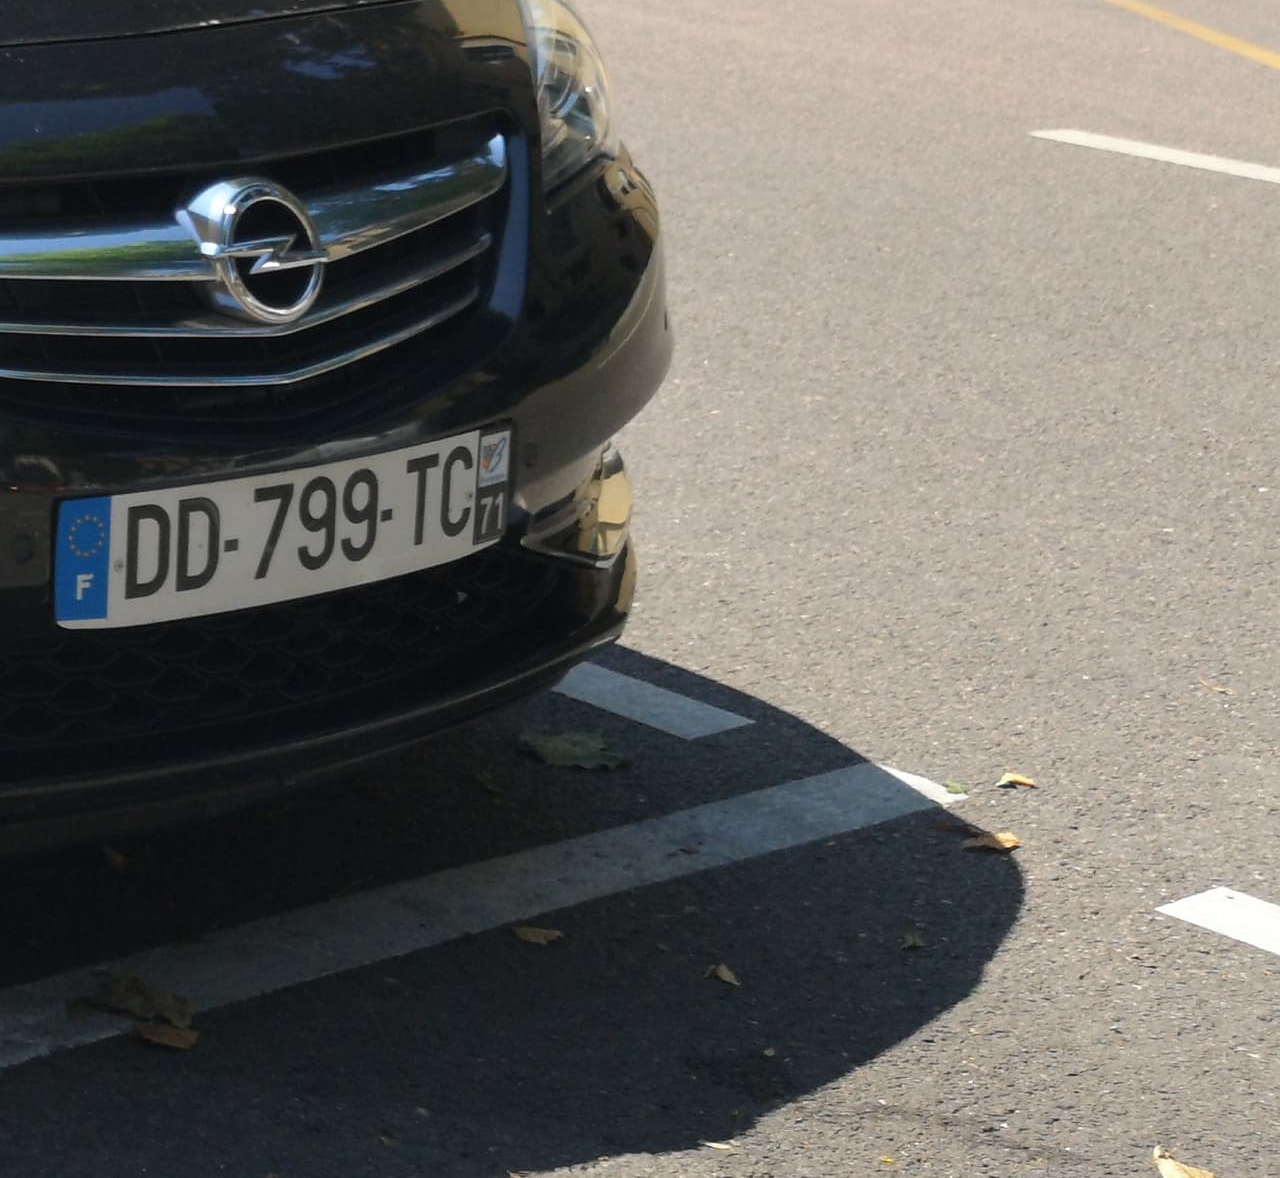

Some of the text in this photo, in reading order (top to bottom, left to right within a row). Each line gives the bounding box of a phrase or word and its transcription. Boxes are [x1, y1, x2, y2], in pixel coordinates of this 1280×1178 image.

[125, 446, 473, 599] DD-799-TC
[480, 492, 504, 534] 71
[76, 574, 93, 601] F
